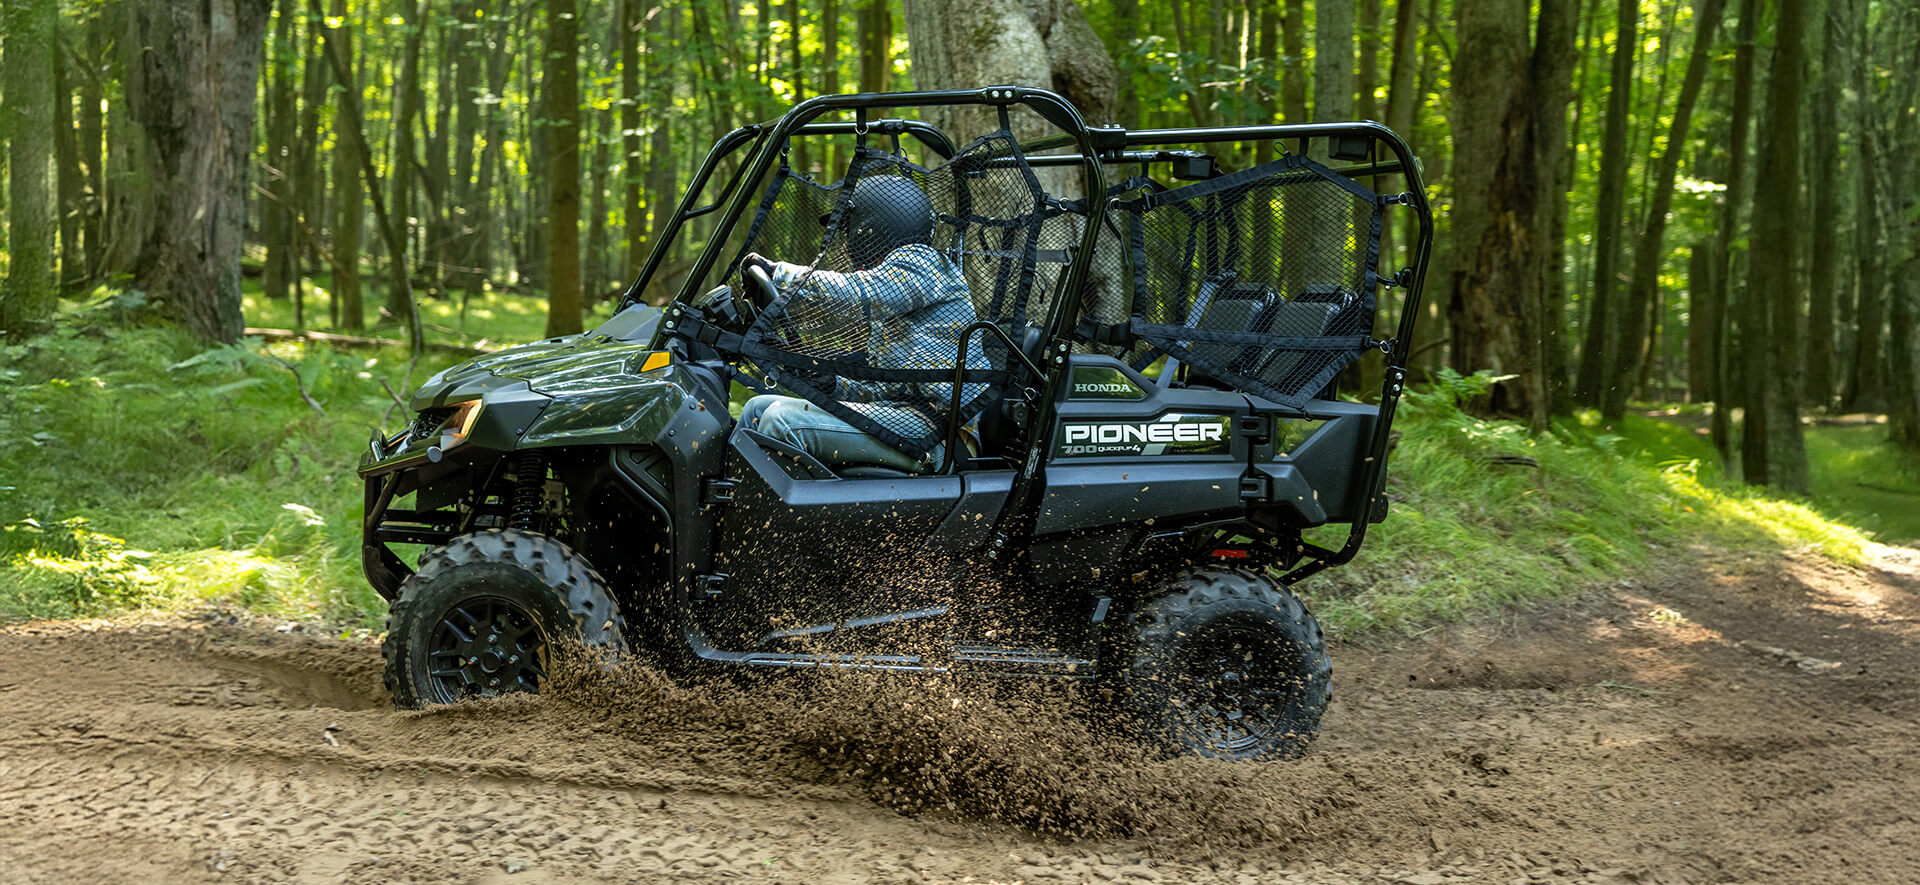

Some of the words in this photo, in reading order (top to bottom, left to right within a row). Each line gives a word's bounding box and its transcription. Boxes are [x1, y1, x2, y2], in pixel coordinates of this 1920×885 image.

[1074, 383, 1132, 393] HONDA
[1065, 423, 1223, 444] PIONEER
[1061, 445, 1097, 454] 700
